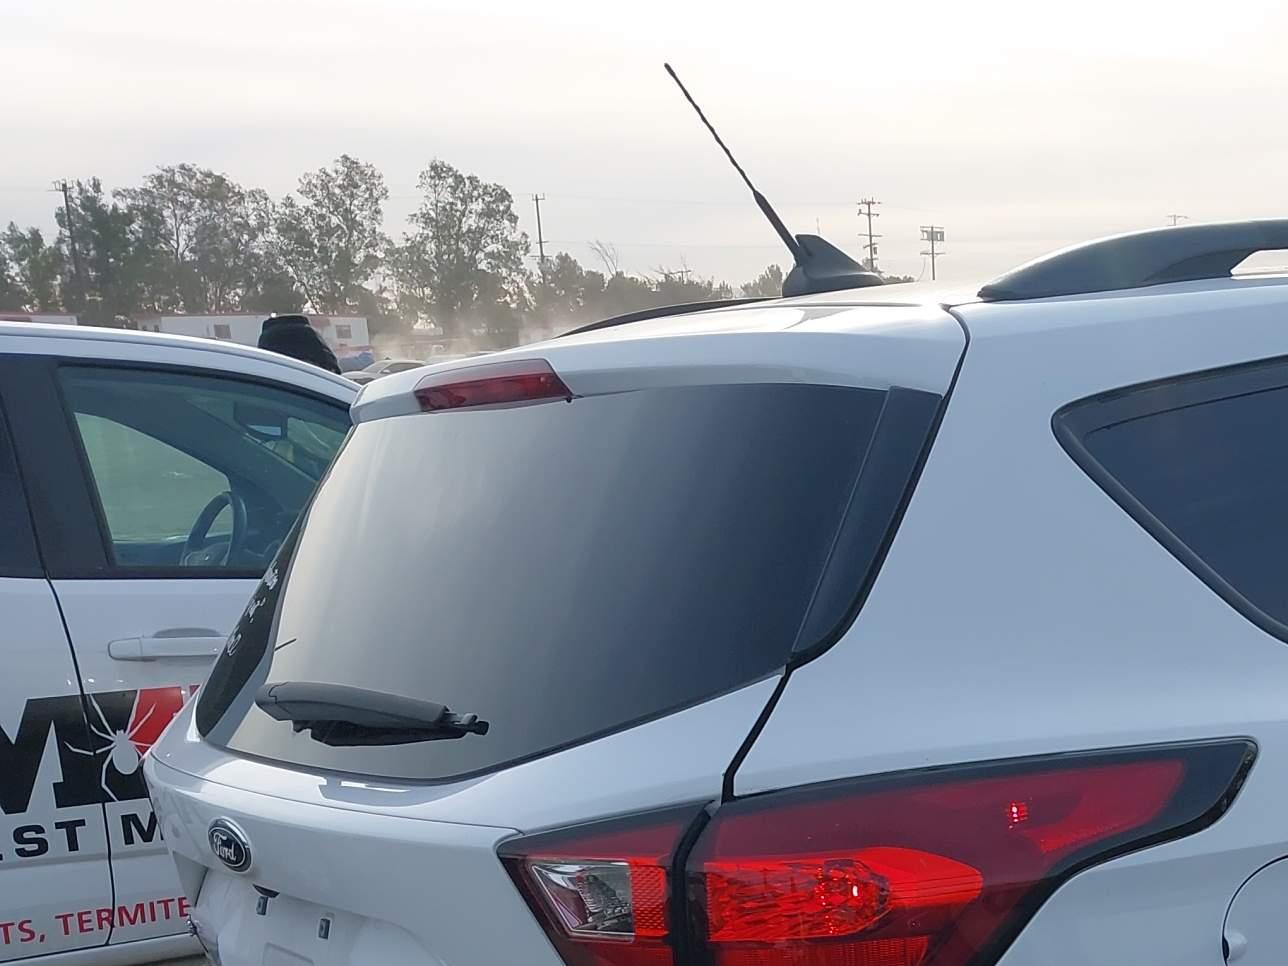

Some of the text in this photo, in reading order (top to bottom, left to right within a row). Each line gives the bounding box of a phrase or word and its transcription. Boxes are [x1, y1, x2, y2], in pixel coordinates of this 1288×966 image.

[0, 818, 86, 862] ST
[213, 833, 237, 862] Ford
[55, 897, 190, 937] TERMITE
